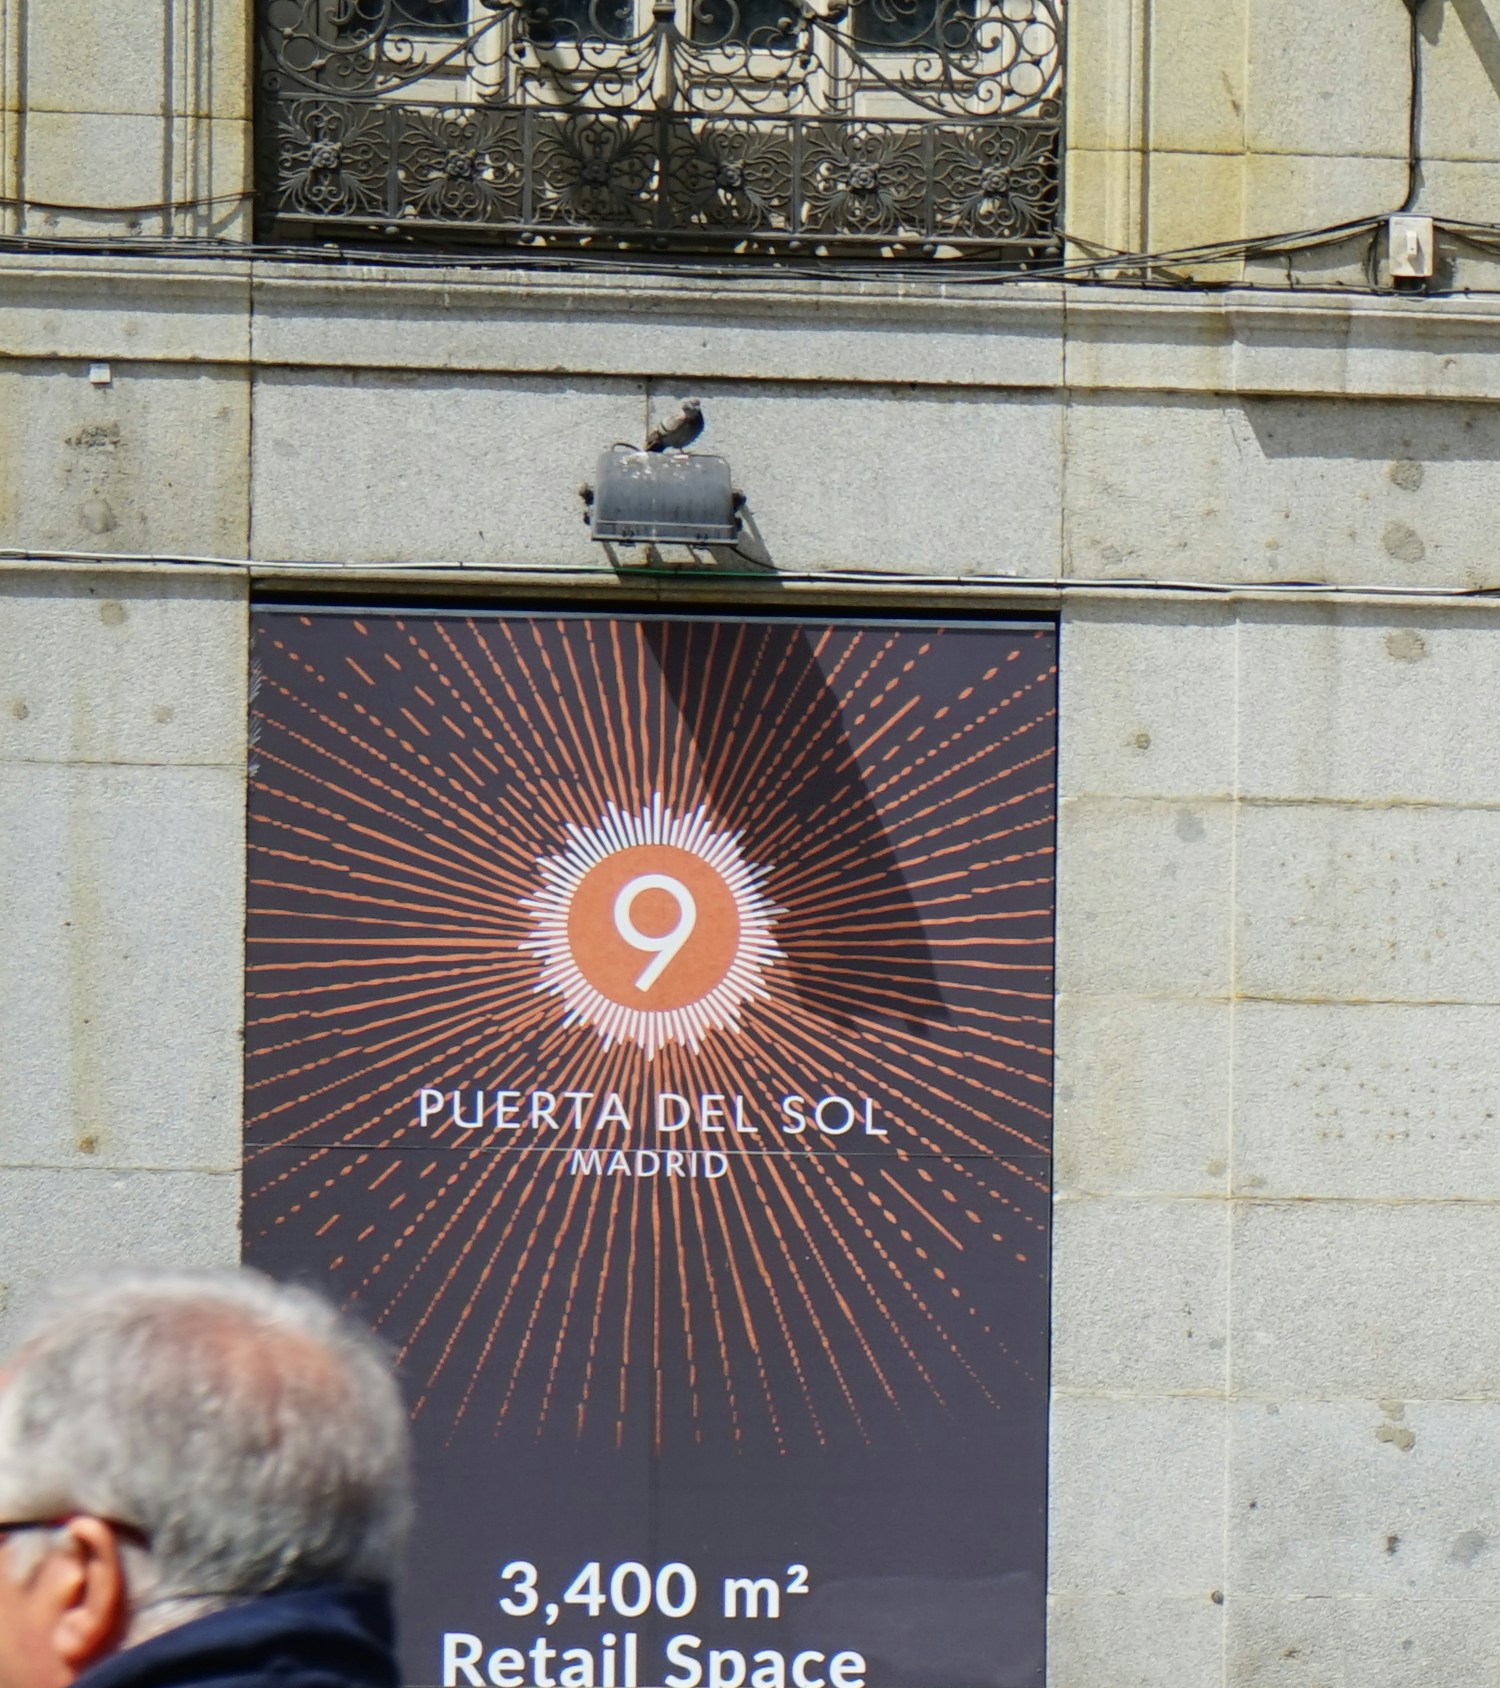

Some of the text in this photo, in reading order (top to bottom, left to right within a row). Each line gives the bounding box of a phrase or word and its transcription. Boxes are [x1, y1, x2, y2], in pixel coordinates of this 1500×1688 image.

[613, 873, 698, 992] 9
[419, 1089, 888, 1137] PUERTA DEL SOL
[569, 1148, 729, 1179] MADRID
[500, 1561, 697, 1625] 3,400
[442, 1632, 638, 1688] Retail
